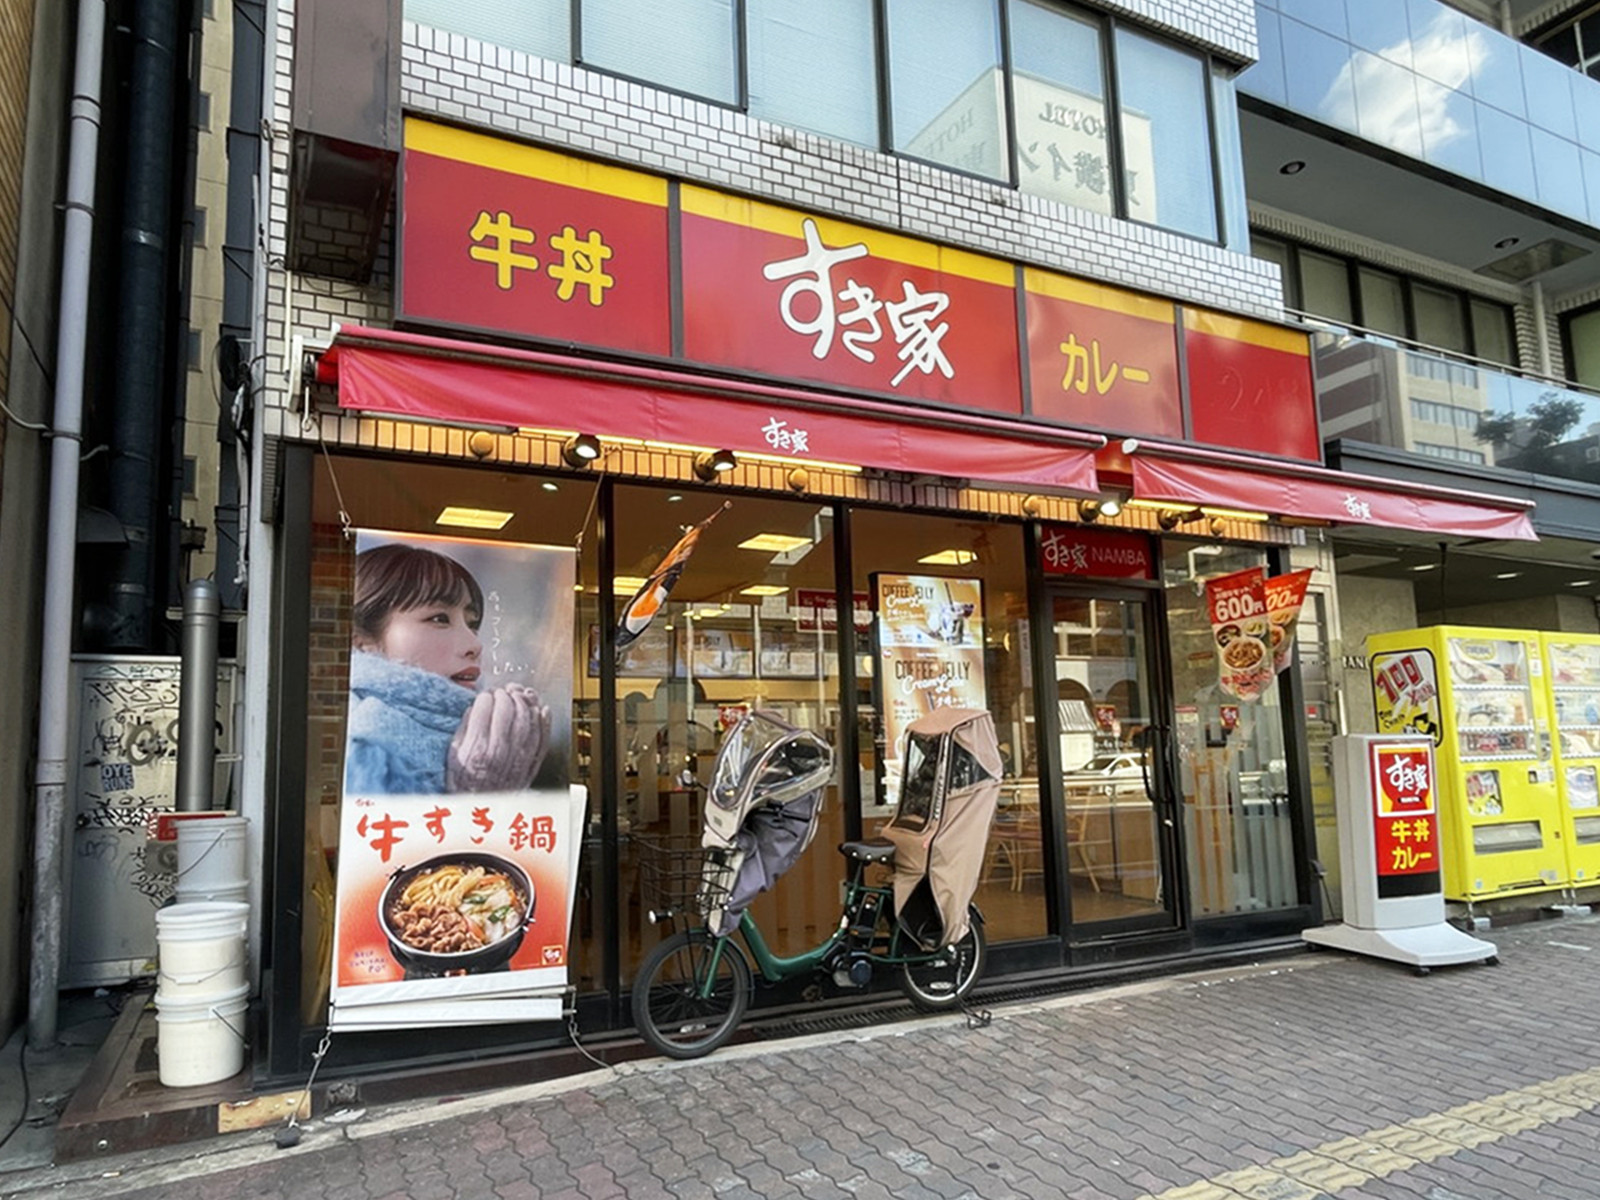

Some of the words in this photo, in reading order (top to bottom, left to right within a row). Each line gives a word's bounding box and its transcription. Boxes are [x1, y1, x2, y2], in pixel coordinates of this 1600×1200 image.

[469, 210, 615, 308] 牛丼
[763, 217, 956, 388] すき家
[1059, 332, 1150, 395] カレー
[761, 416, 810, 455] すき家
[1041, 529, 1089, 572] すき家
[1091, 546, 1146, 566] NAMBA
[1385, 754, 1429, 796] すき家
[356, 805, 557, 863] 牛すき鍋
[1391, 818, 1430, 844] 牛丼
[1391, 846, 1432, 871] カレー
